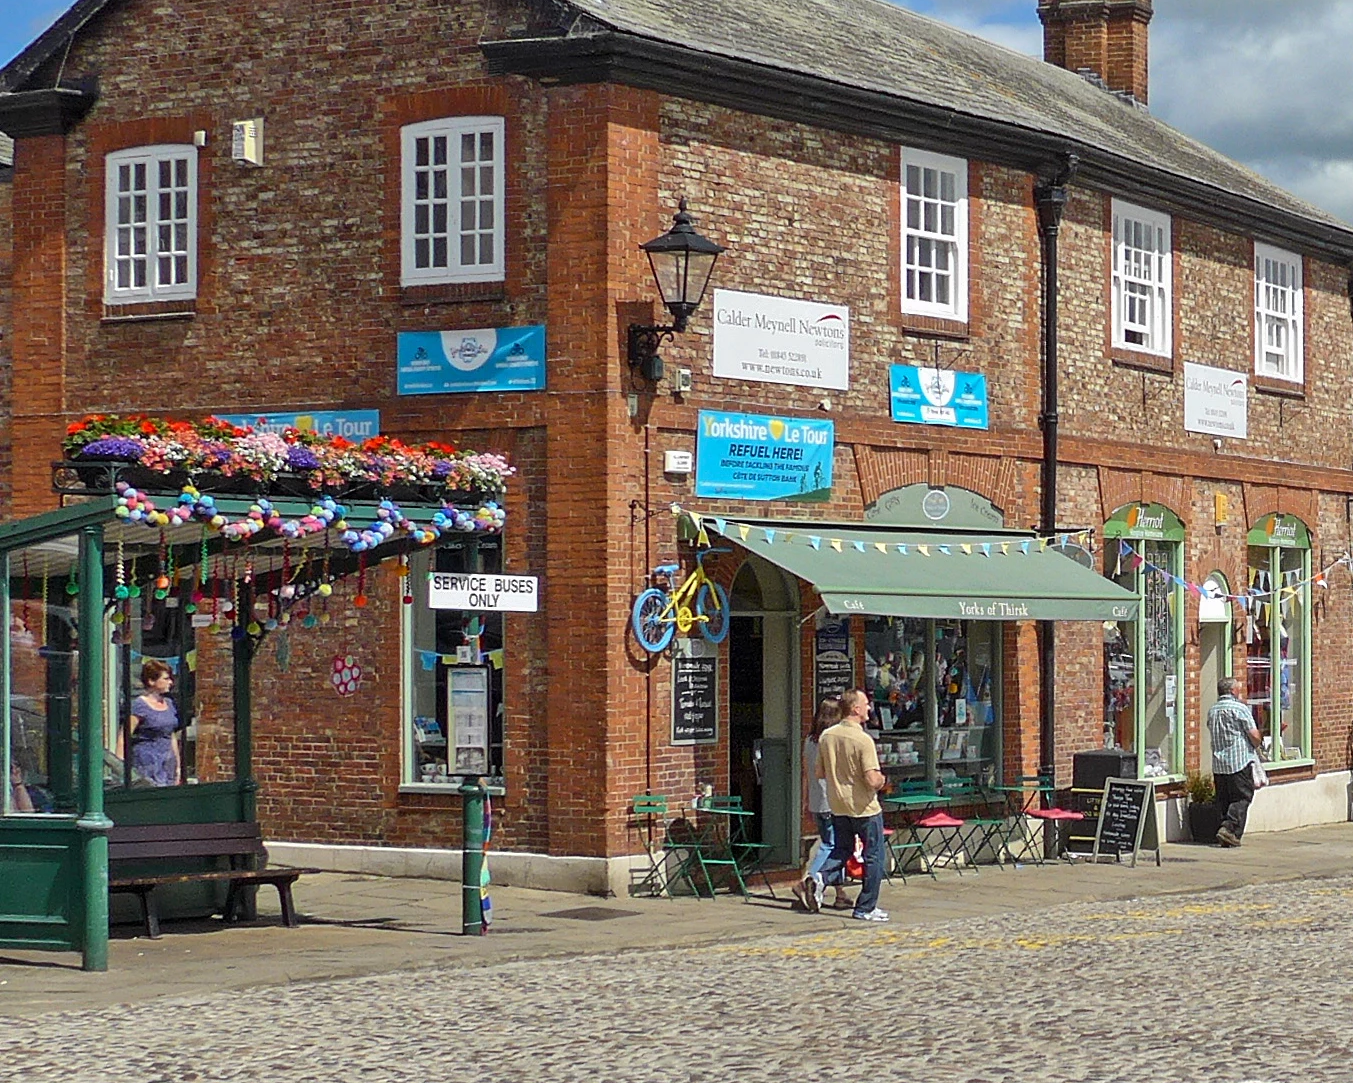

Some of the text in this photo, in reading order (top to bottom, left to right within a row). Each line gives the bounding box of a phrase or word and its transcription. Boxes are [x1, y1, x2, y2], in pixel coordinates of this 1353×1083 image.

[718, 308, 845, 339] Calder Meynell Newtons
[741, 361, 822, 379] www.newtons.co.uk
[336, 419, 373, 436] Tour
[704, 415, 827, 445] Yorkshire Le Tour
[729, 444, 803, 461] REFUEL HERE!
[434, 576, 533, 594] SERVICE BUSES
[469, 593, 500, 608] ONLY
[959, 601, 984, 616] Yorks
[987, 602, 996, 616] of
[998, 602, 1028, 617] Thirsk
